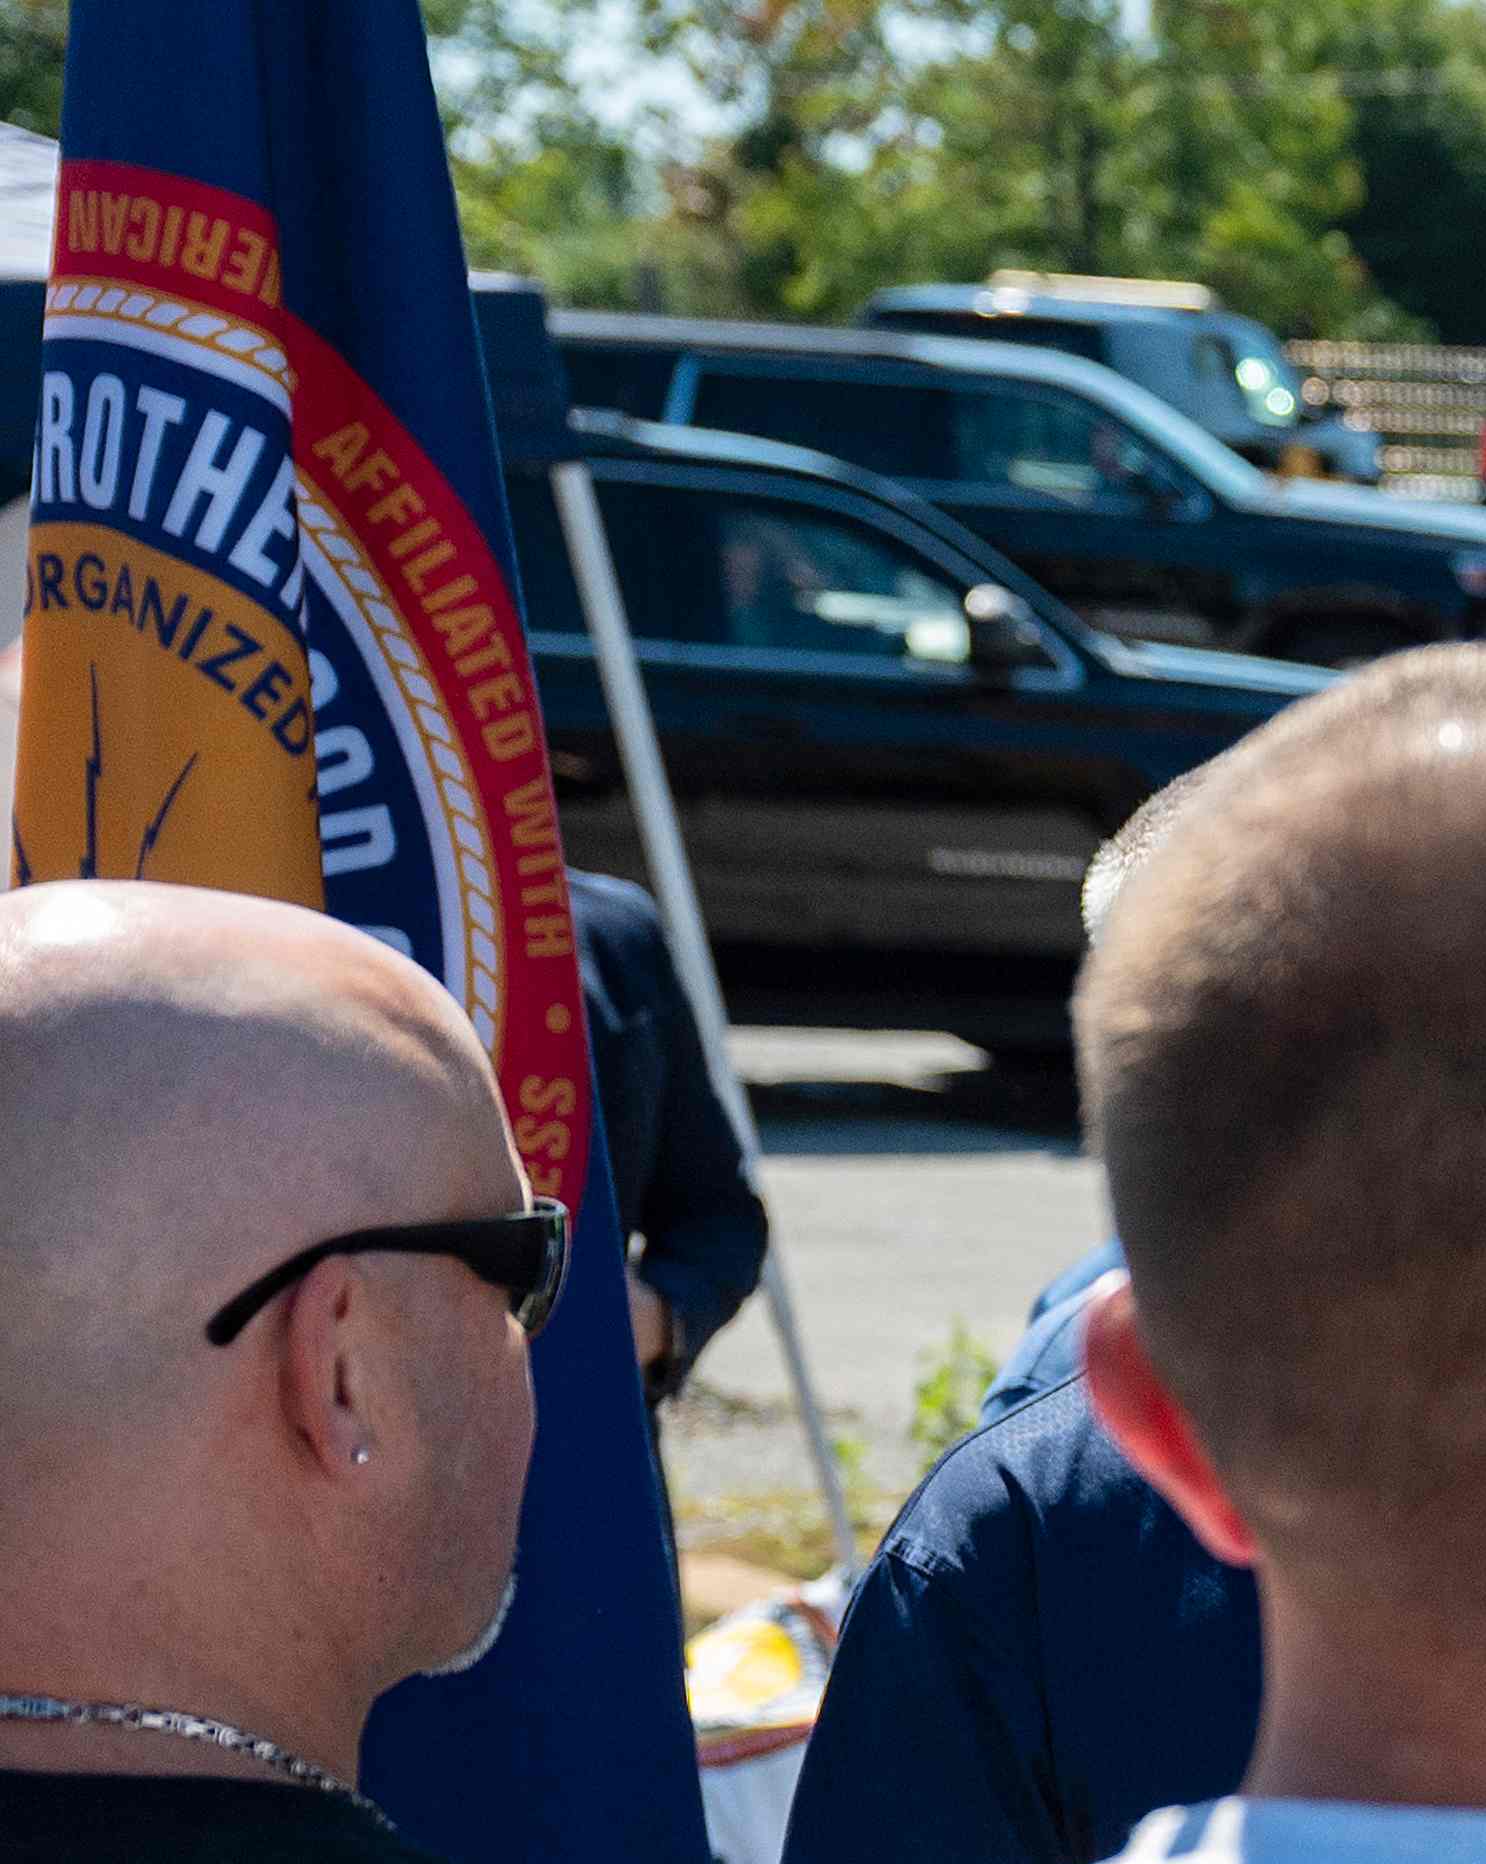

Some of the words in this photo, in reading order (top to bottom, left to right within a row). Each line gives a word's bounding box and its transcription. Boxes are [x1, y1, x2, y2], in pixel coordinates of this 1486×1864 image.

[32, 371, 303, 609] ROTHE
[26, 553, 313, 758] RGANIZED
[312, 422, 533, 762] AFFILIATED
[504, 775, 575, 959] WITH
